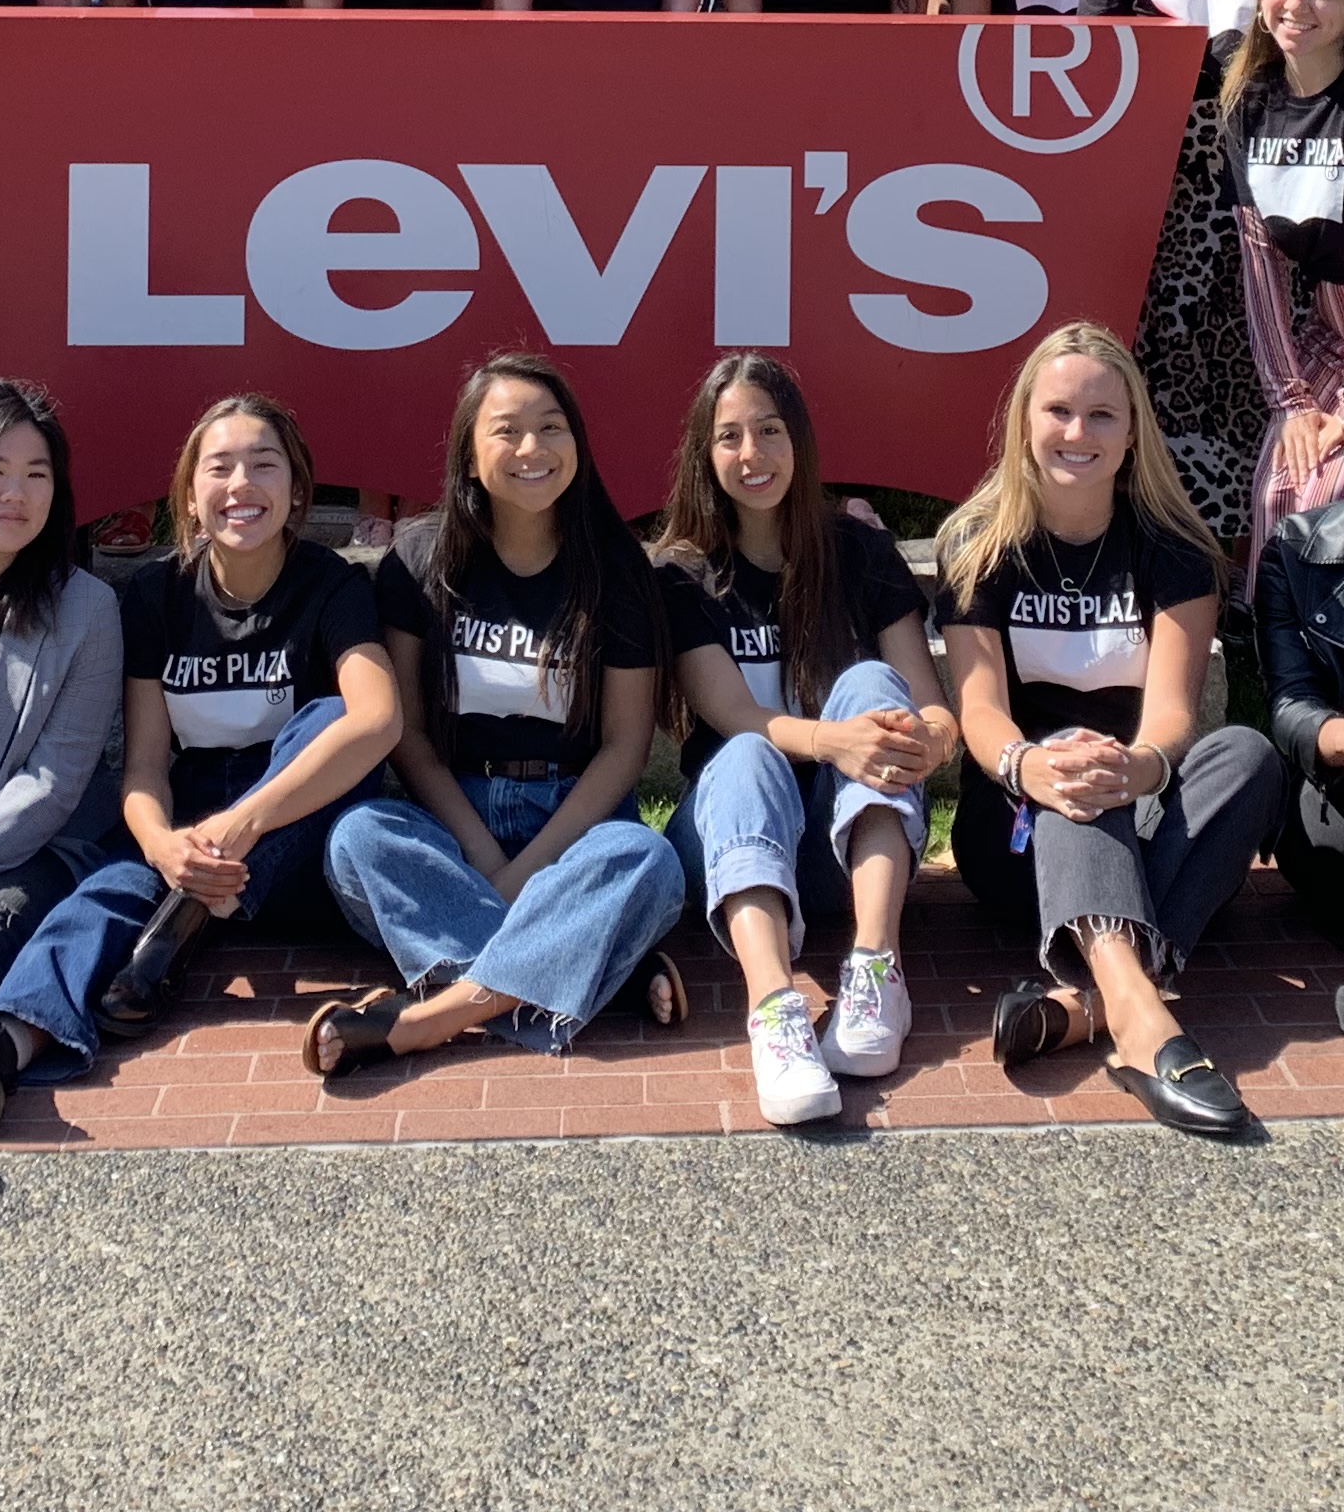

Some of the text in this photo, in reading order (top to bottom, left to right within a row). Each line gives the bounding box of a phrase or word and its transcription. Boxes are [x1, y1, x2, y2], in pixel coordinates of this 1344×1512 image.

[66, 150, 1049, 354] Levi's
[1072, 591, 1143, 626] PLAZ
[226, 649, 293, 684] PLAZA
